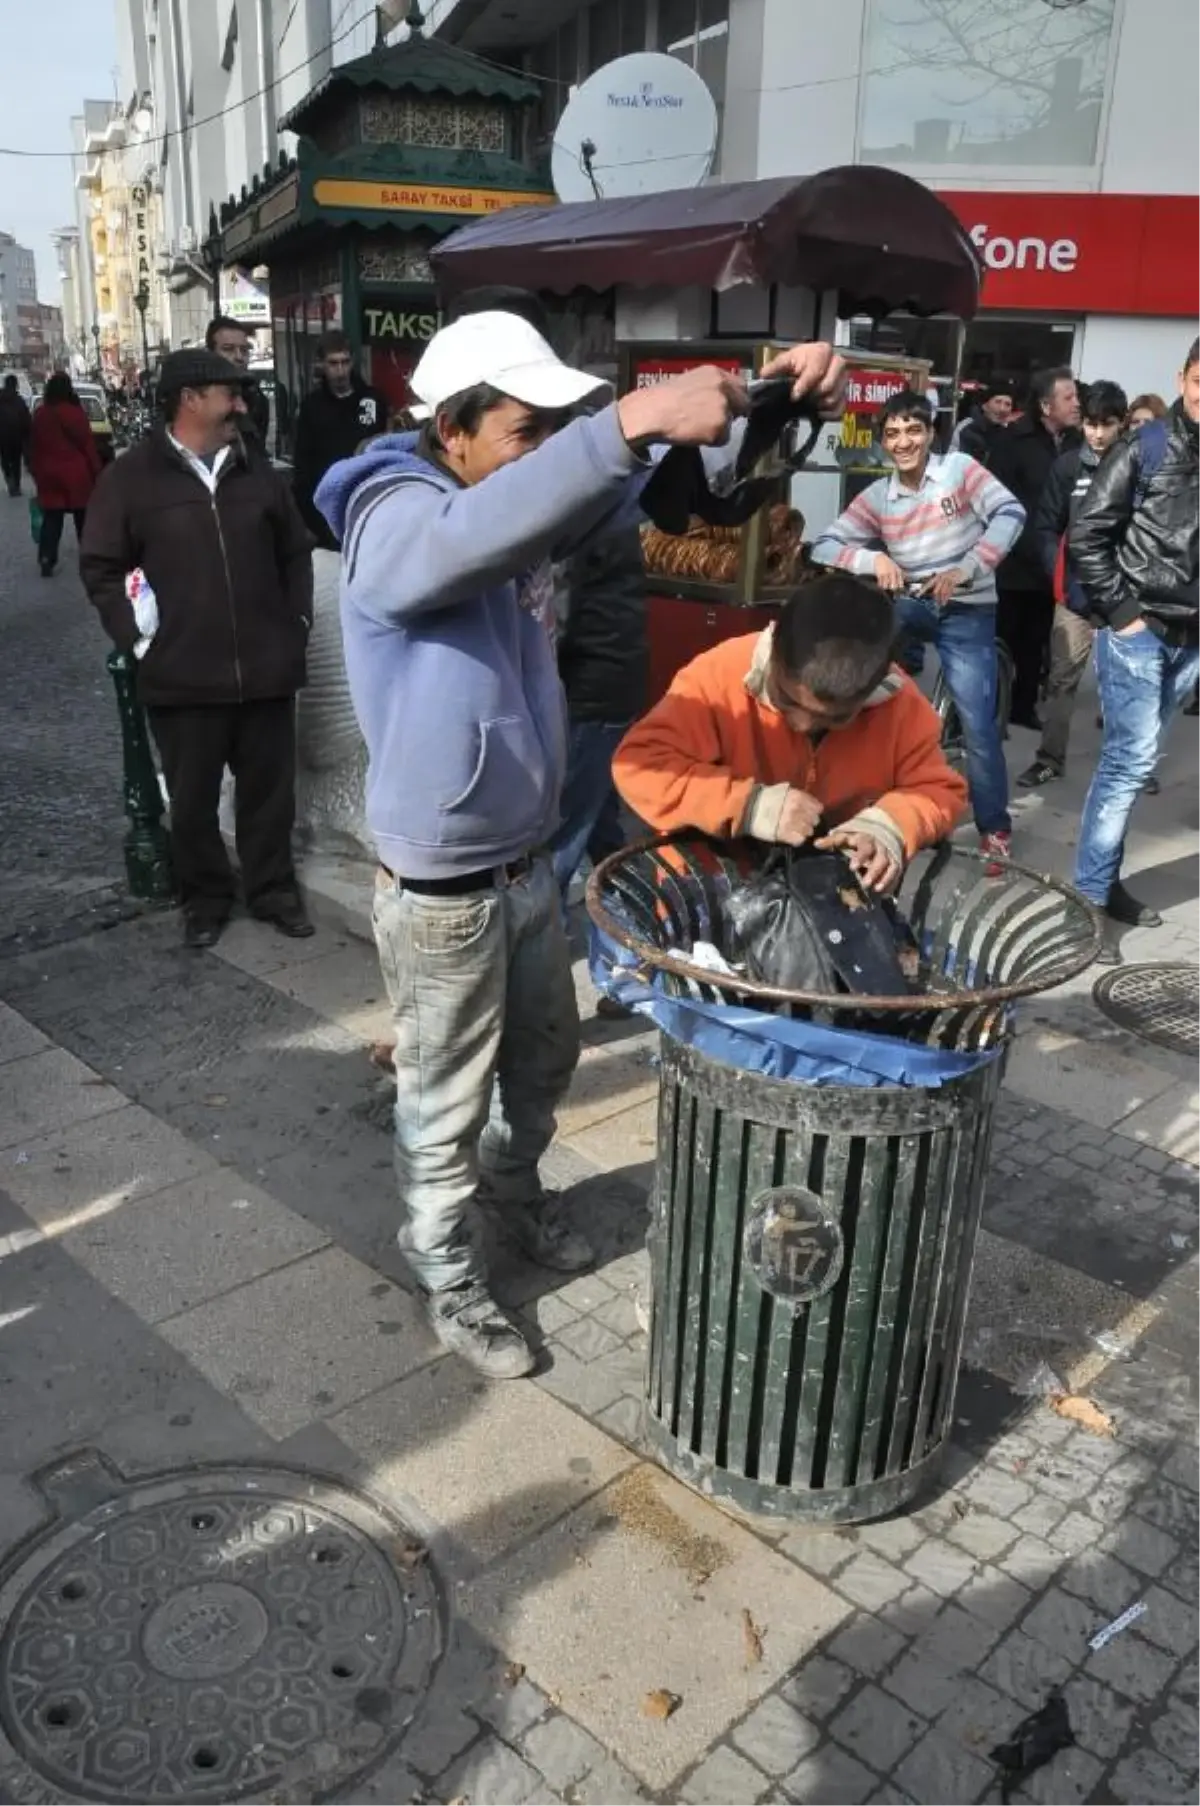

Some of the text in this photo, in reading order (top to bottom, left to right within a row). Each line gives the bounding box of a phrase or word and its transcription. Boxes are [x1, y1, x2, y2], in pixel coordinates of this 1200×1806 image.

[381, 190, 426, 206] SARAY
[431, 193, 473, 209] TAKSİ
[969, 223, 1079, 273] fone
